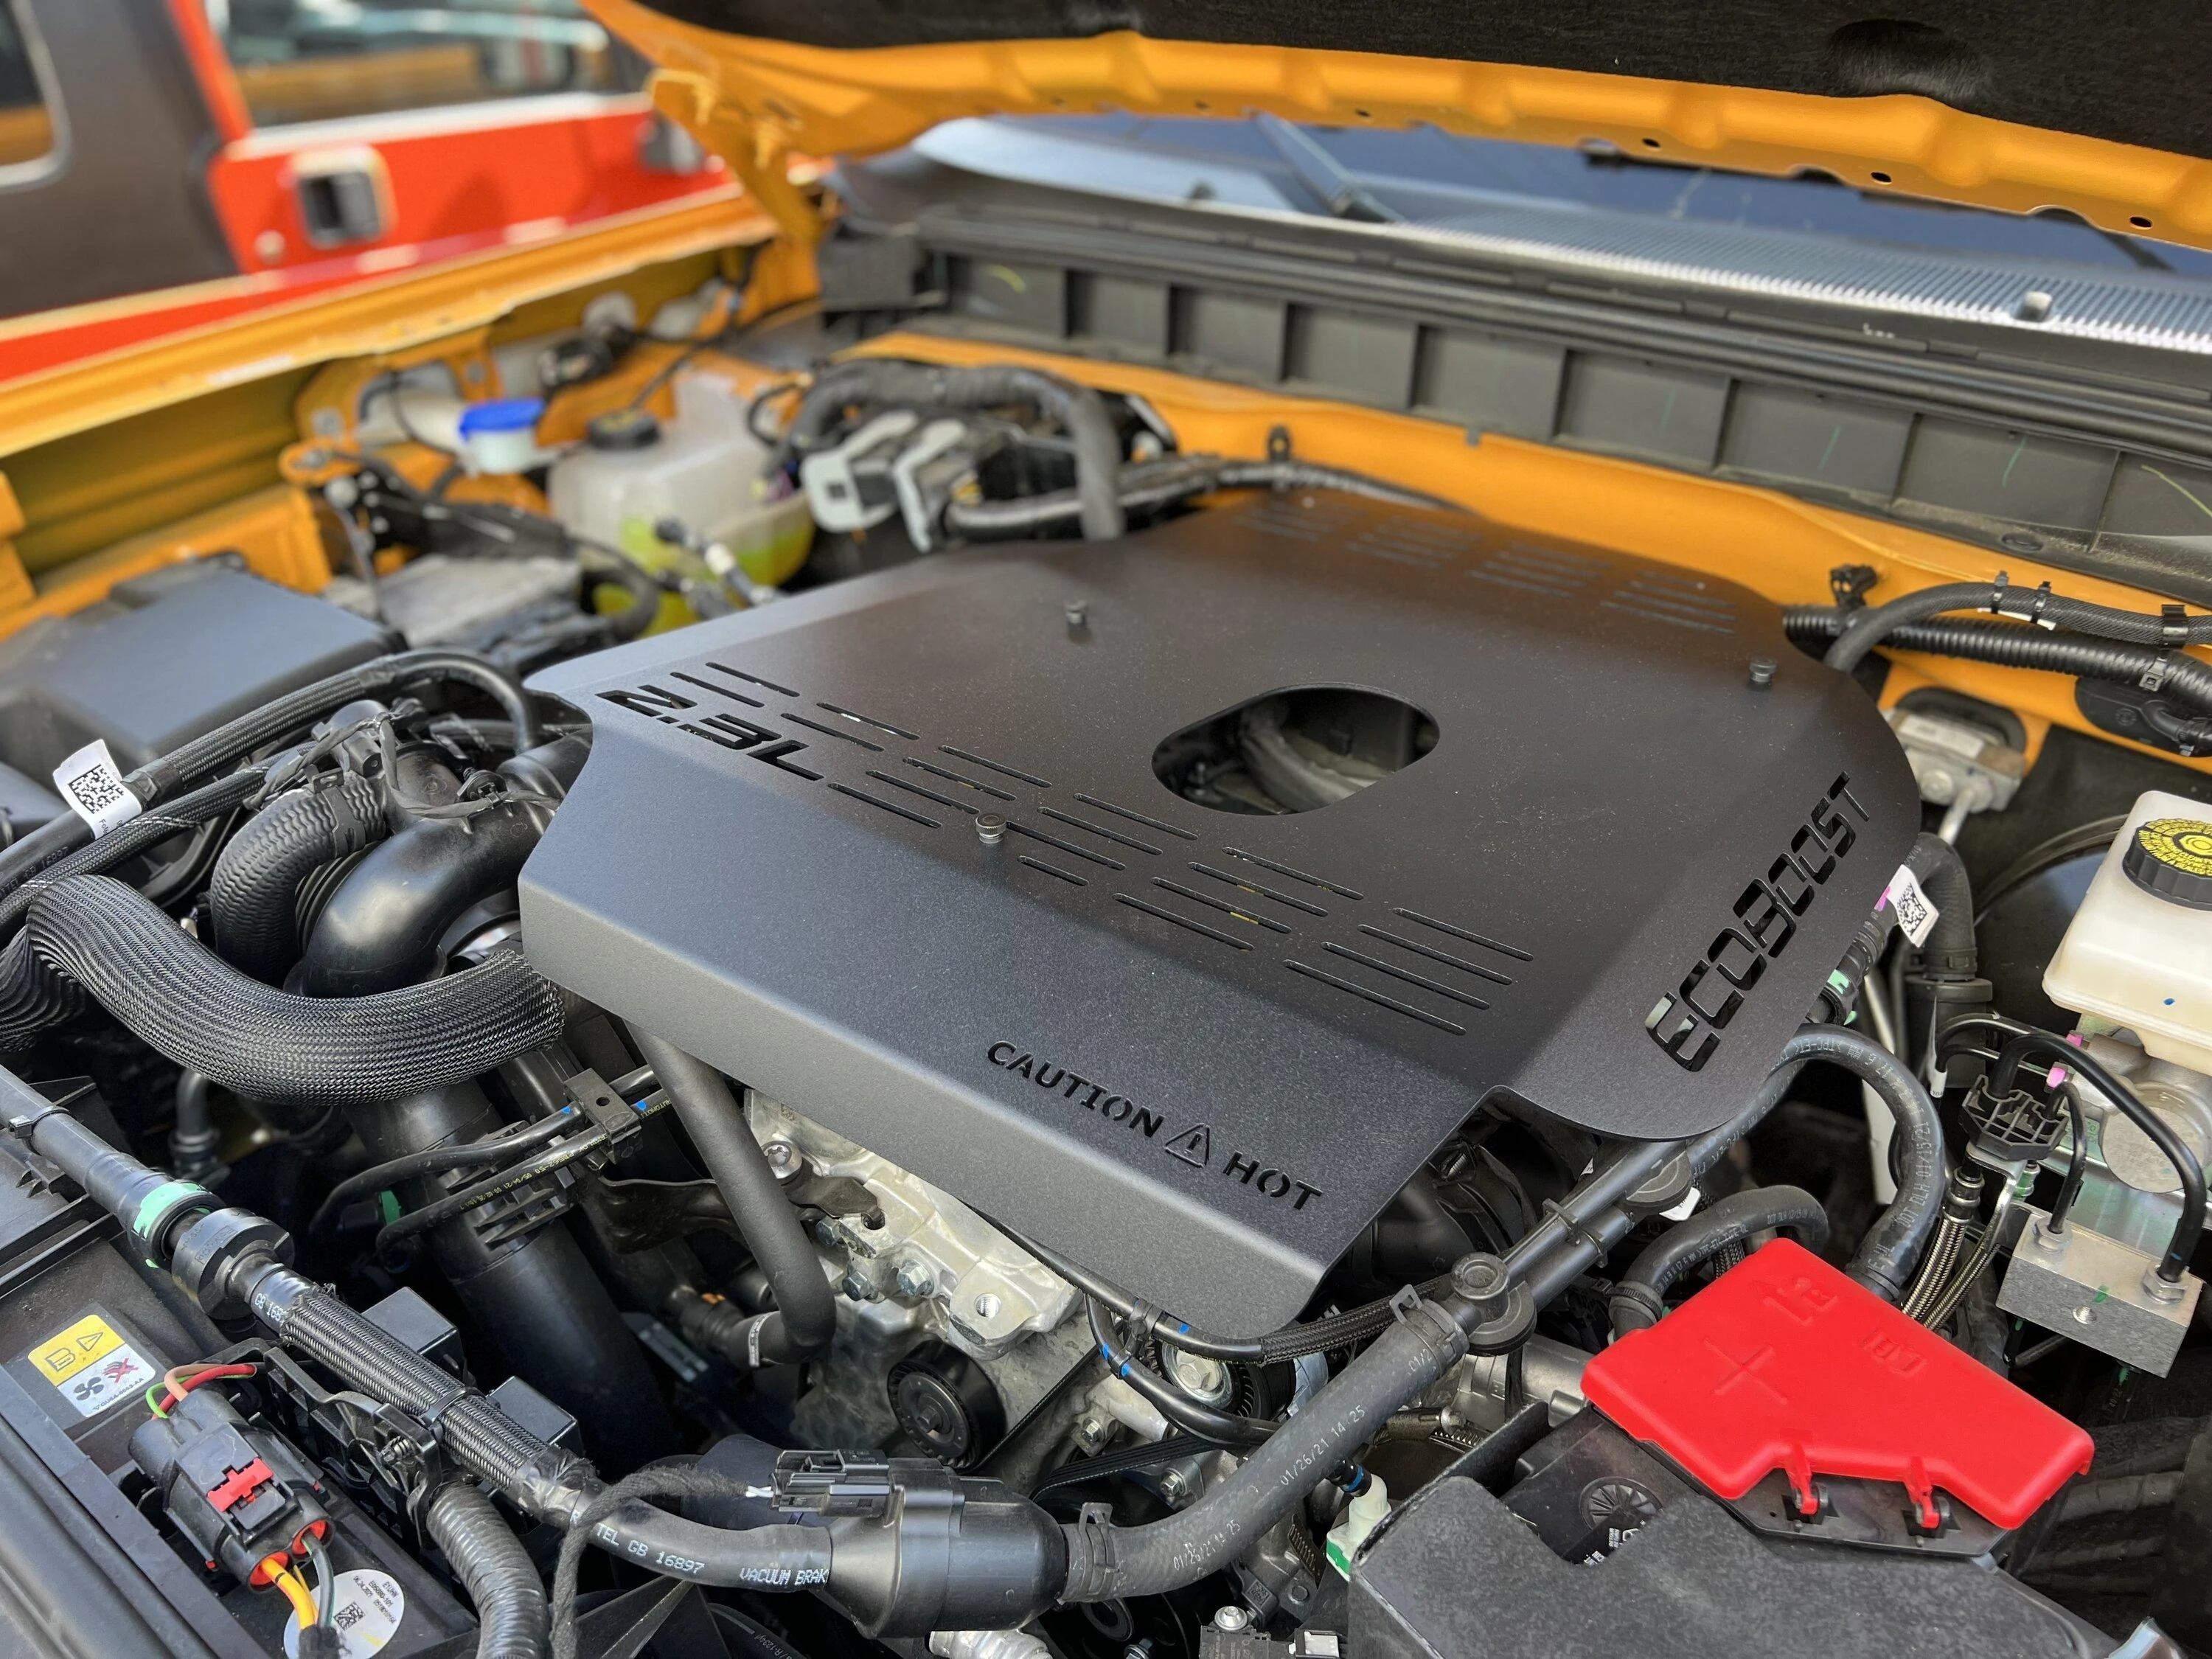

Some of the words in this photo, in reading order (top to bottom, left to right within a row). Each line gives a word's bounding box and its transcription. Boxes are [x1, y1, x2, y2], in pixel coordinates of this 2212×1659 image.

[594, 684, 825, 782] 2.3L
[1644, 771, 1871, 1073] ECOBOOST
[987, 1040, 1165, 1138] CAUTION
[1222, 1150, 1323, 1211] HOT
[1914, 1122, 1930, 1178] 01/15/21
[254, 1293, 266, 1309] GB
[1278, 1438, 1330, 1488] 01/26/21
[627, 1540, 648, 1557] GB
[655, 1551, 705, 1575] 16897
[740, 1568, 790, 1585] VACUUM
